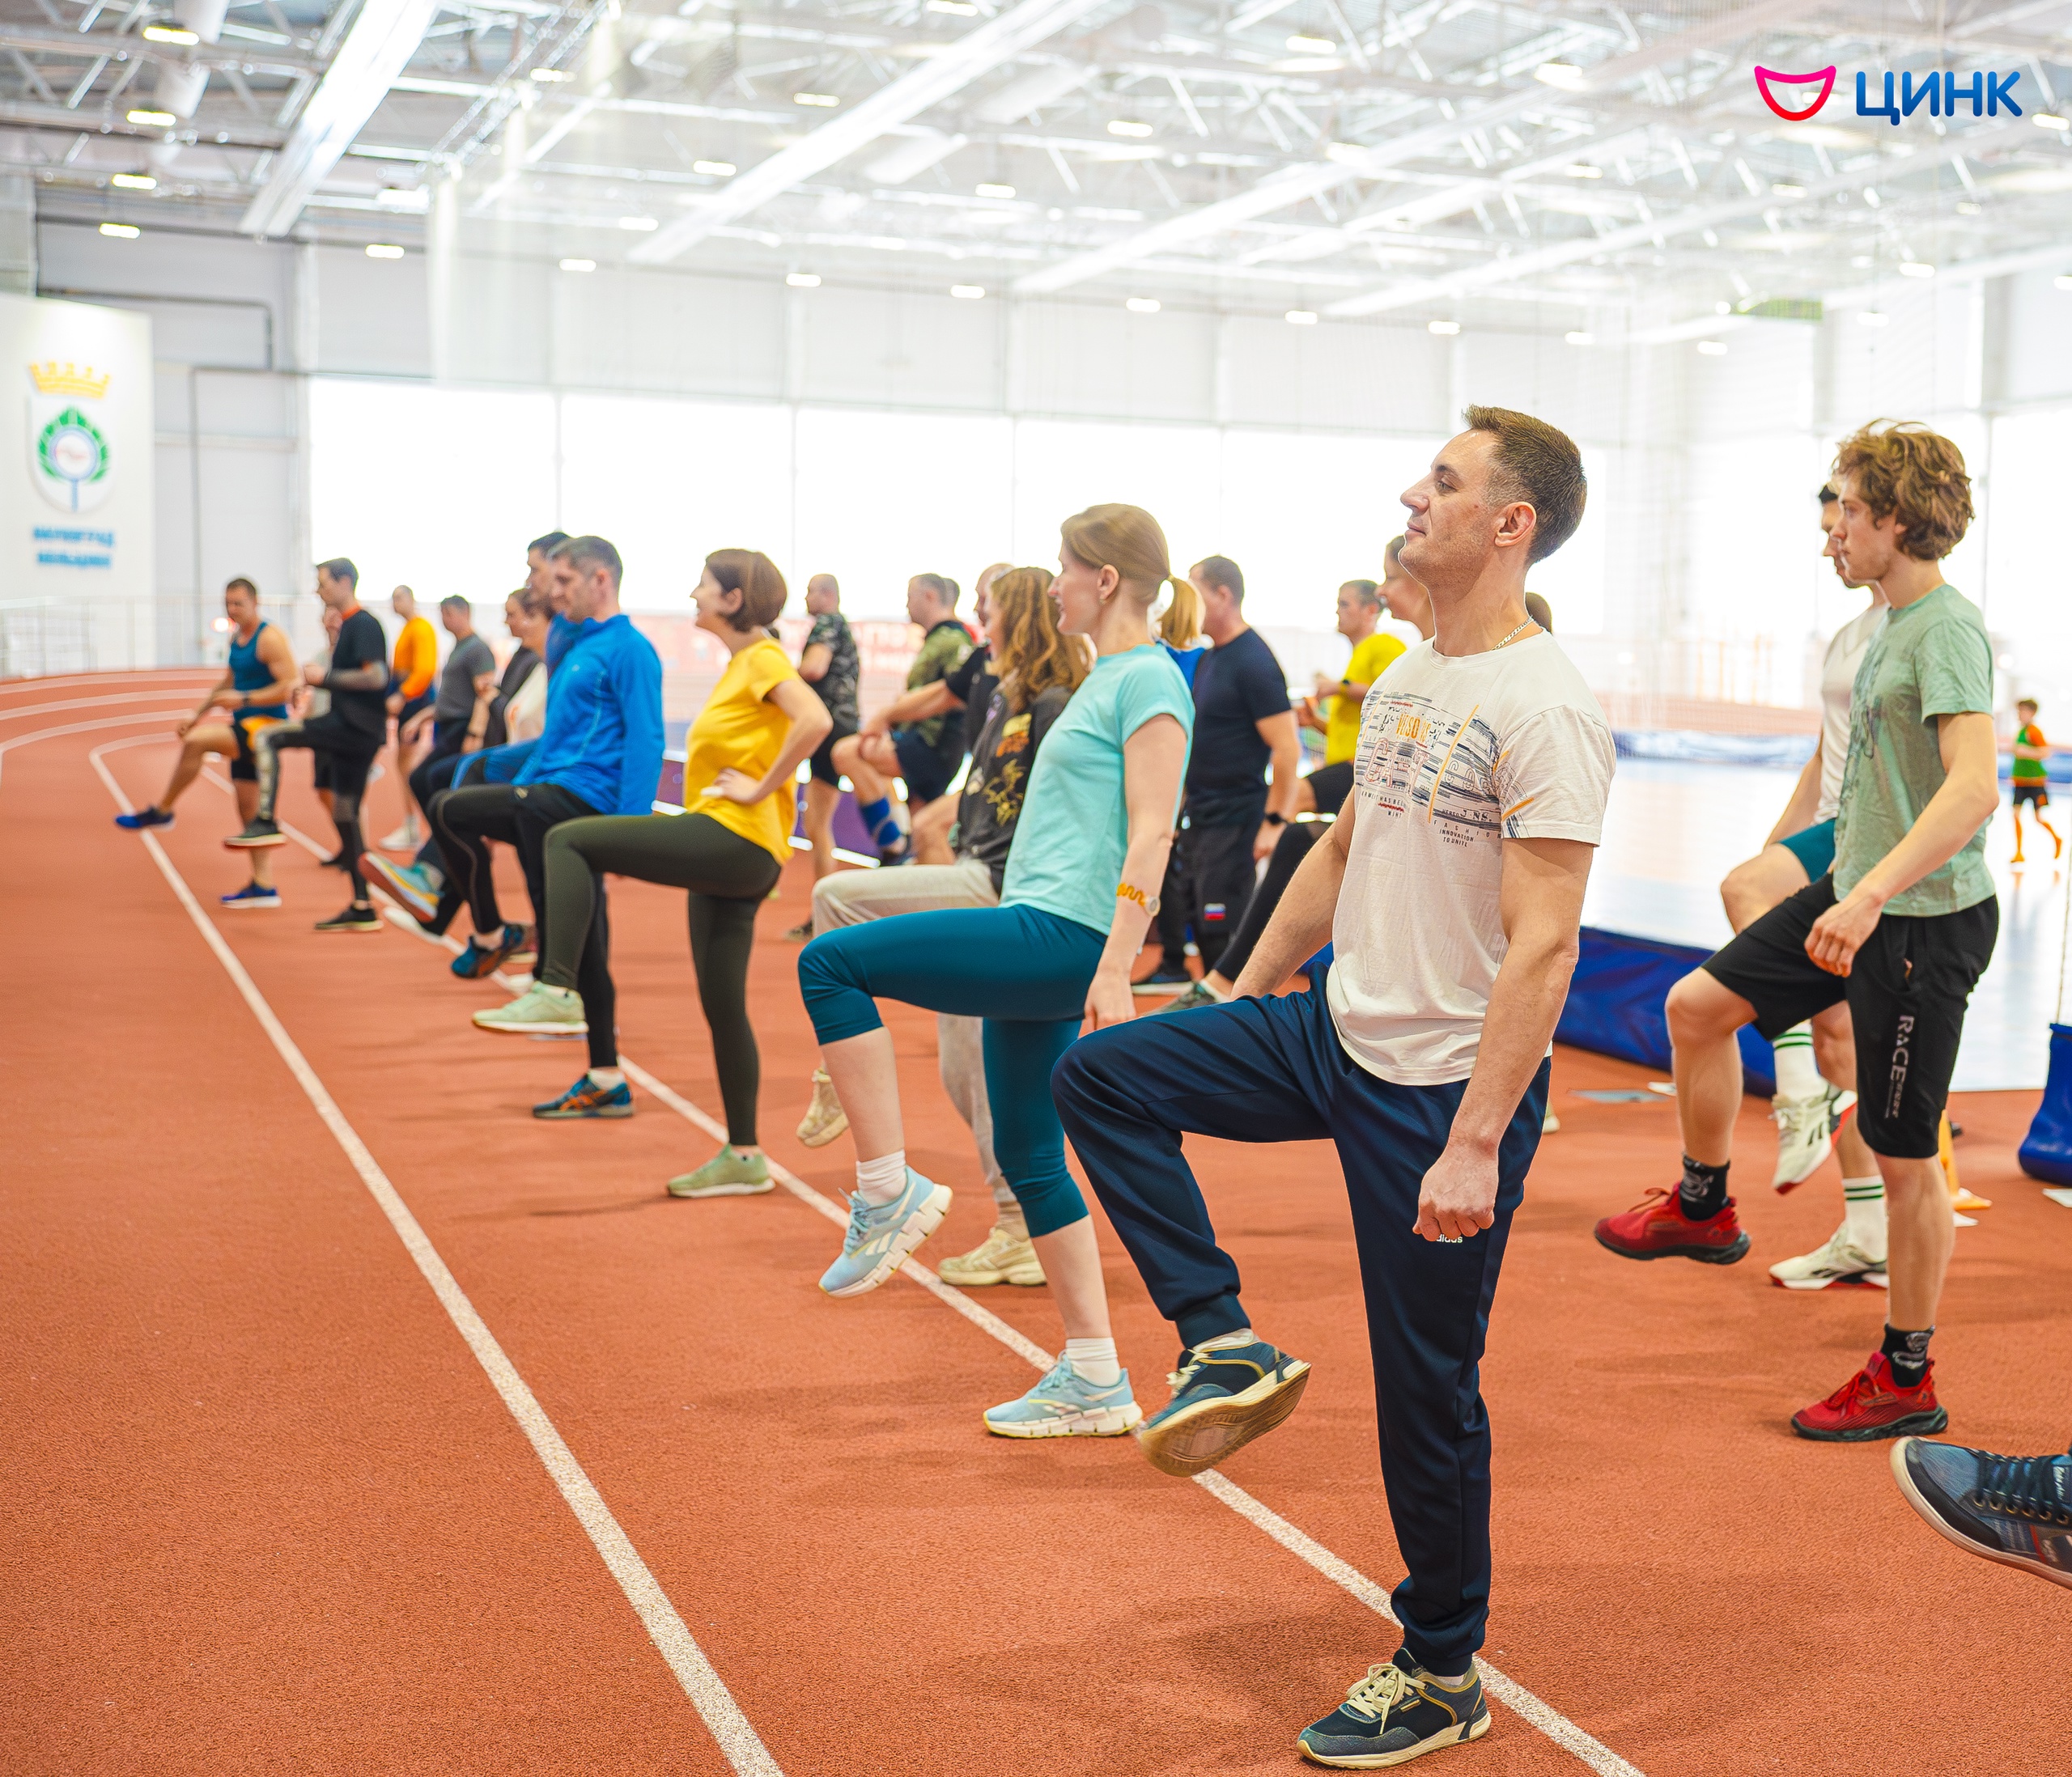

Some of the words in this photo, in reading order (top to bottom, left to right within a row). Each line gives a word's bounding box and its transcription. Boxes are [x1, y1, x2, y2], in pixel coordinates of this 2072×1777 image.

[1433, 820, 1501, 839] FASHION
[1439, 829, 1474, 842] INNOVATION
[1451, 838, 1468, 848] UNITE
[1891, 1015, 1914, 1084] RACE
